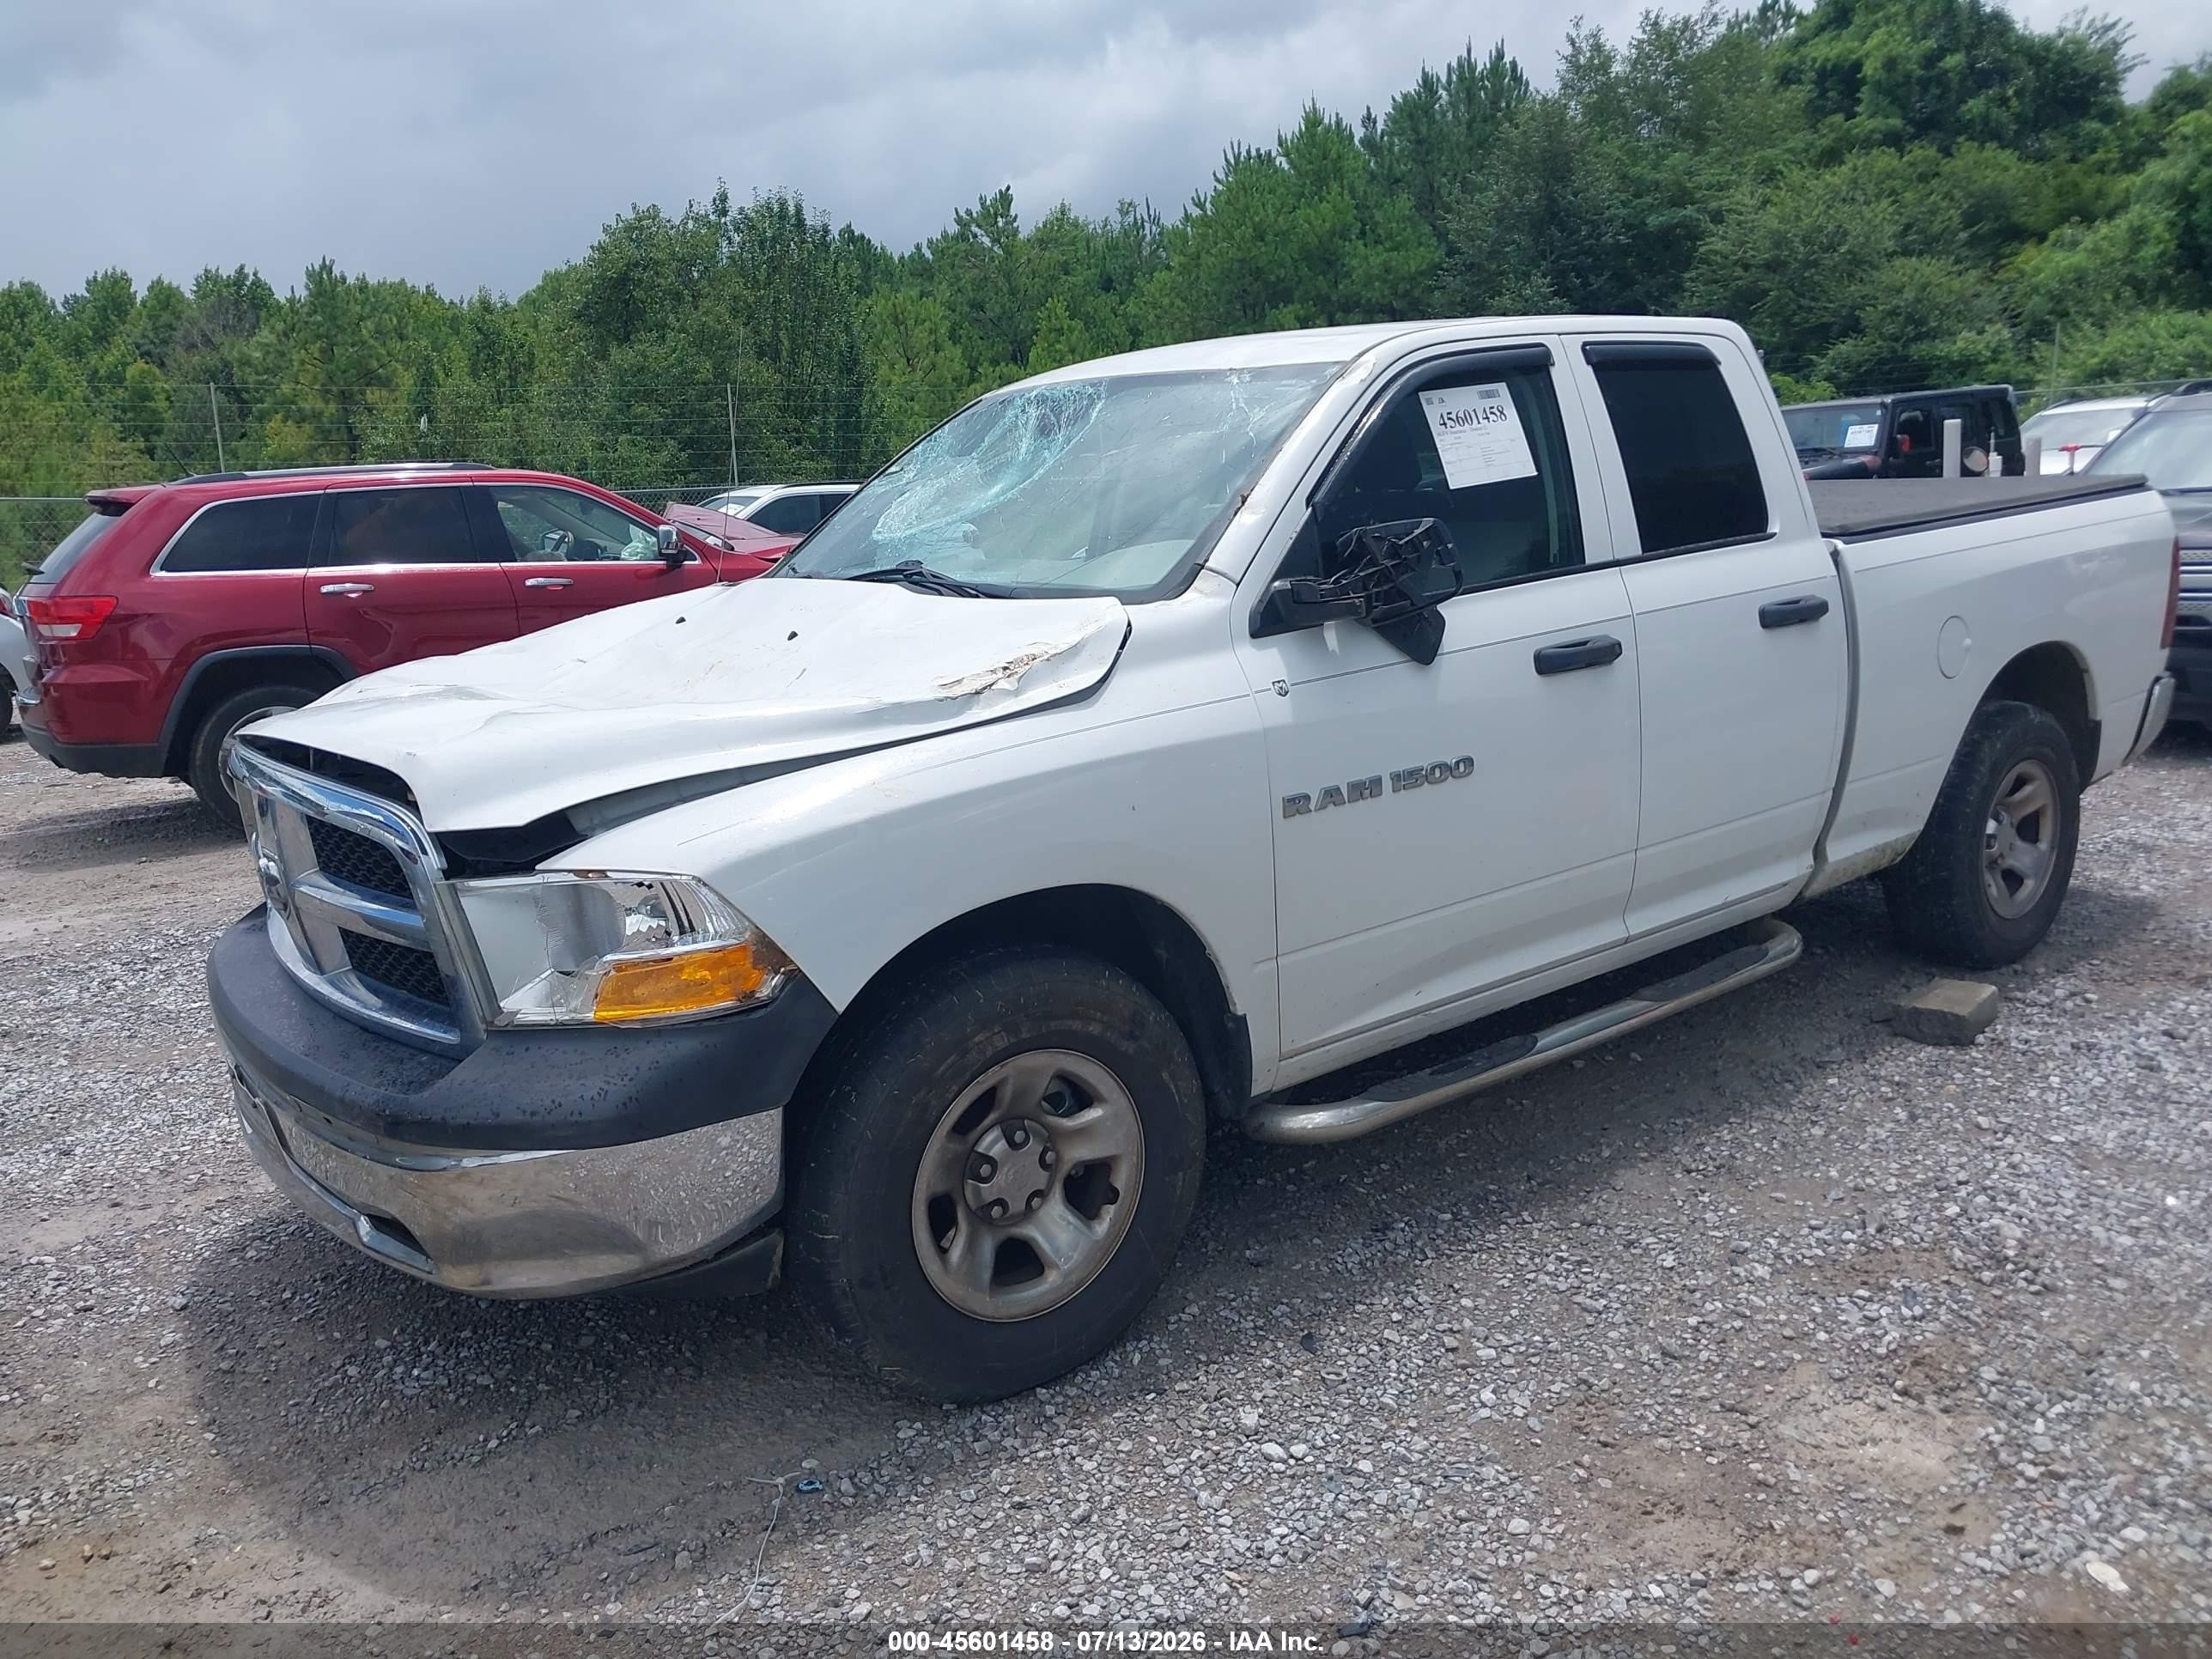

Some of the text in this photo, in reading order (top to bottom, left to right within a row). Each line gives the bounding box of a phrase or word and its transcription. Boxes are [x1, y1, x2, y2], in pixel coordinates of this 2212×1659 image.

[1438, 404, 1507, 429] 45601458
[1282, 755, 1474, 818] RAM 1500
